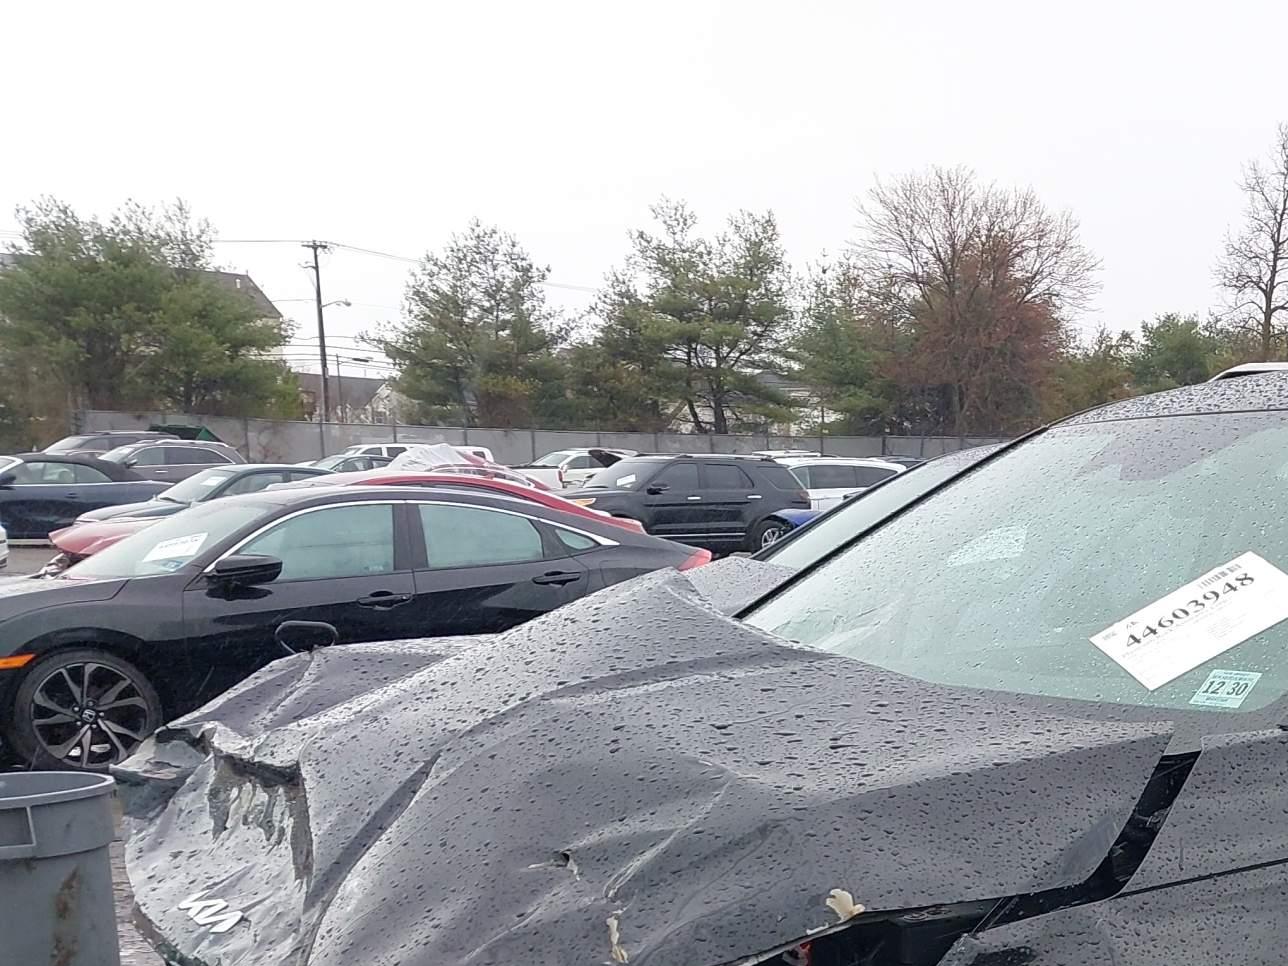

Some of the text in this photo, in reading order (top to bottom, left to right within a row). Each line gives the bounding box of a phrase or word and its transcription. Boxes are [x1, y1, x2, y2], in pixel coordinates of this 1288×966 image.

[1126, 572, 1255, 648] 44603948
[1201, 681, 1249, 696] 12 30
